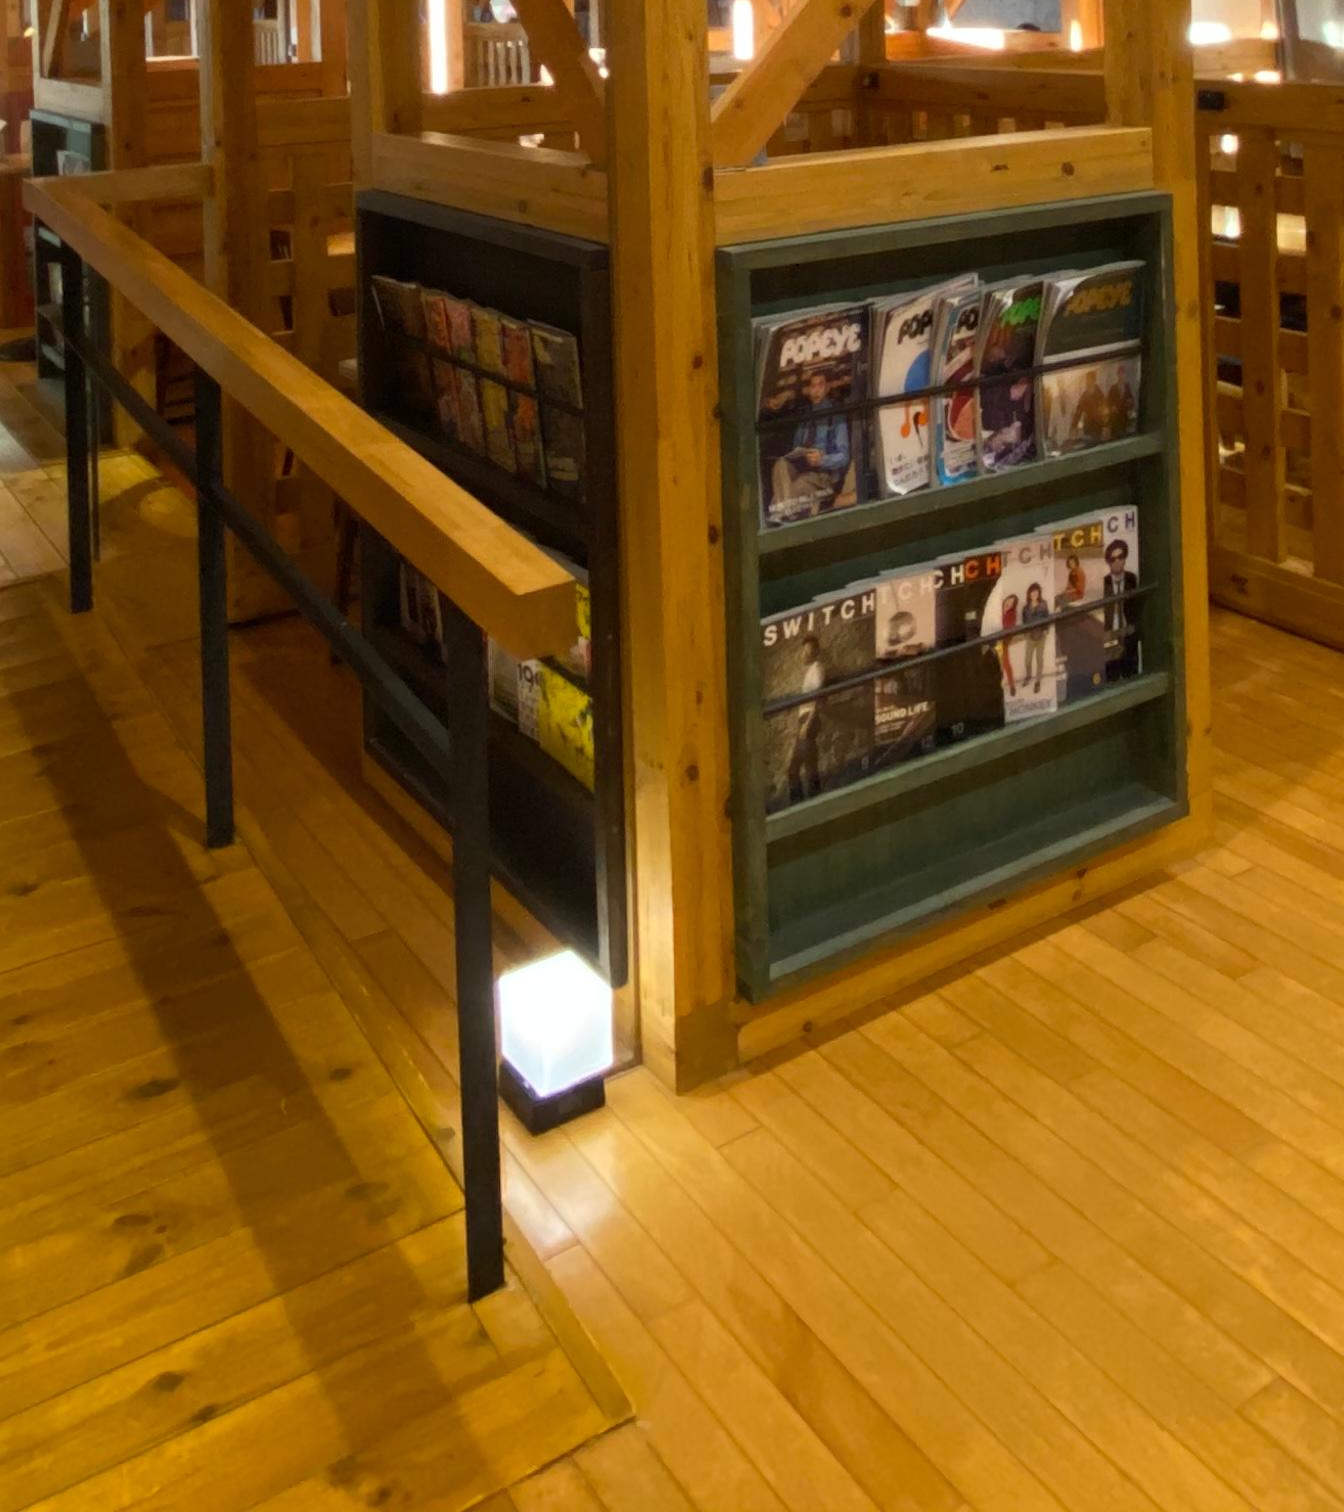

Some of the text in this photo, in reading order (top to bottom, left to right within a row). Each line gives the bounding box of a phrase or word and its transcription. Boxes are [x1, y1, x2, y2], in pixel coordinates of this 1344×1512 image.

[779, 322, 862, 369] POPEYE
[1107, 511, 1136, 534] CH
[965, 553, 1002, 579] CH
[763, 592, 875, 647] SWITCH
